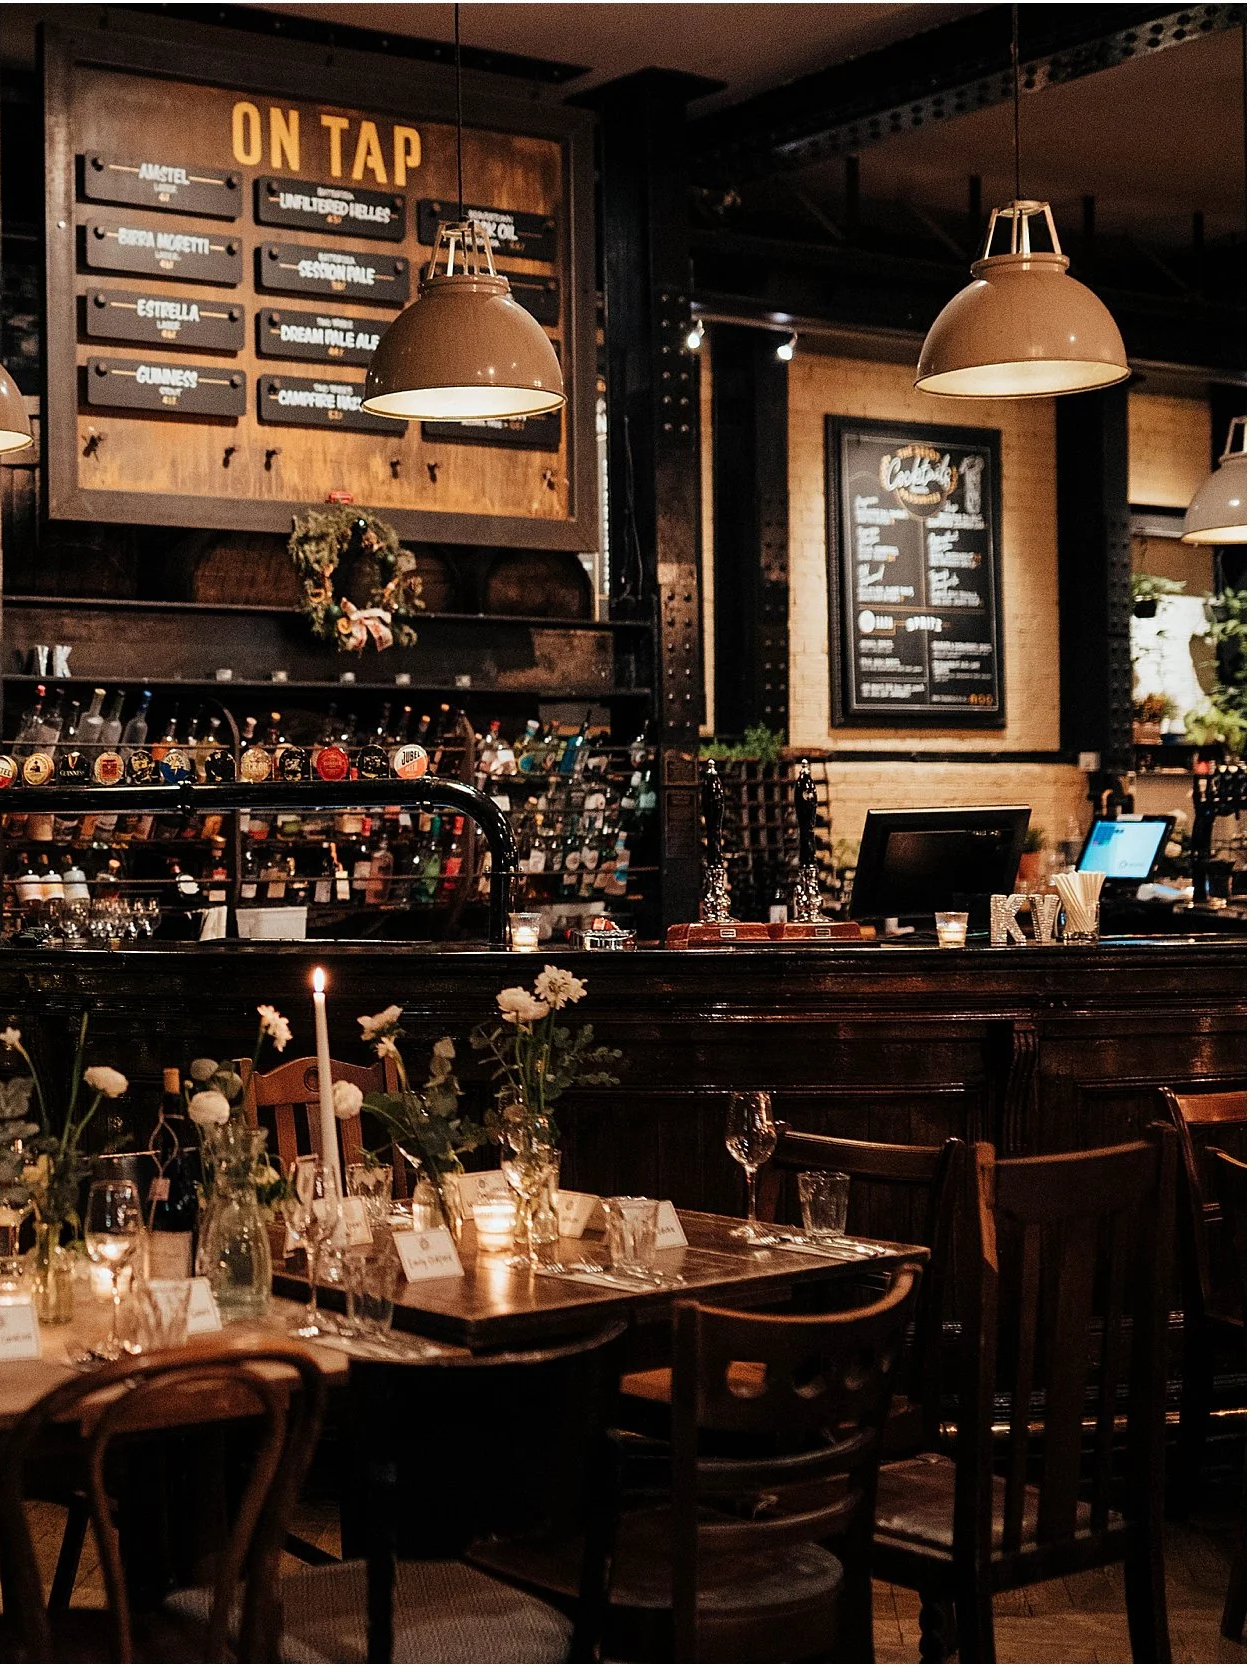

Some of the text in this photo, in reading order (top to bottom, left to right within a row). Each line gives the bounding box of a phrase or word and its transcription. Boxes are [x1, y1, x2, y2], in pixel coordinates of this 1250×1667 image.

[231, 101, 422, 187] ON TAP
[138, 162, 191, 186] AMSTEL
[279, 192, 349, 217] UNFILTERED
[349, 201, 392, 225] HELLES
[118, 226, 156, 248] BIRRA
[157, 231, 210, 256] MORETTI
[297, 259, 347, 281] SESSION
[346, 264, 376, 286] PALE
[137, 298, 201, 323] ESTRELLA
[280, 324, 381, 351] DREAM PALE ALE
[136, 364, 199, 389] GUINNESS
[278, 389, 336, 409] CAMPFIRE
[886, 453, 953, 493] Cocktails
[401, 750, 421, 766] JUBEL
[59, 769, 86, 777] GUINNESS
